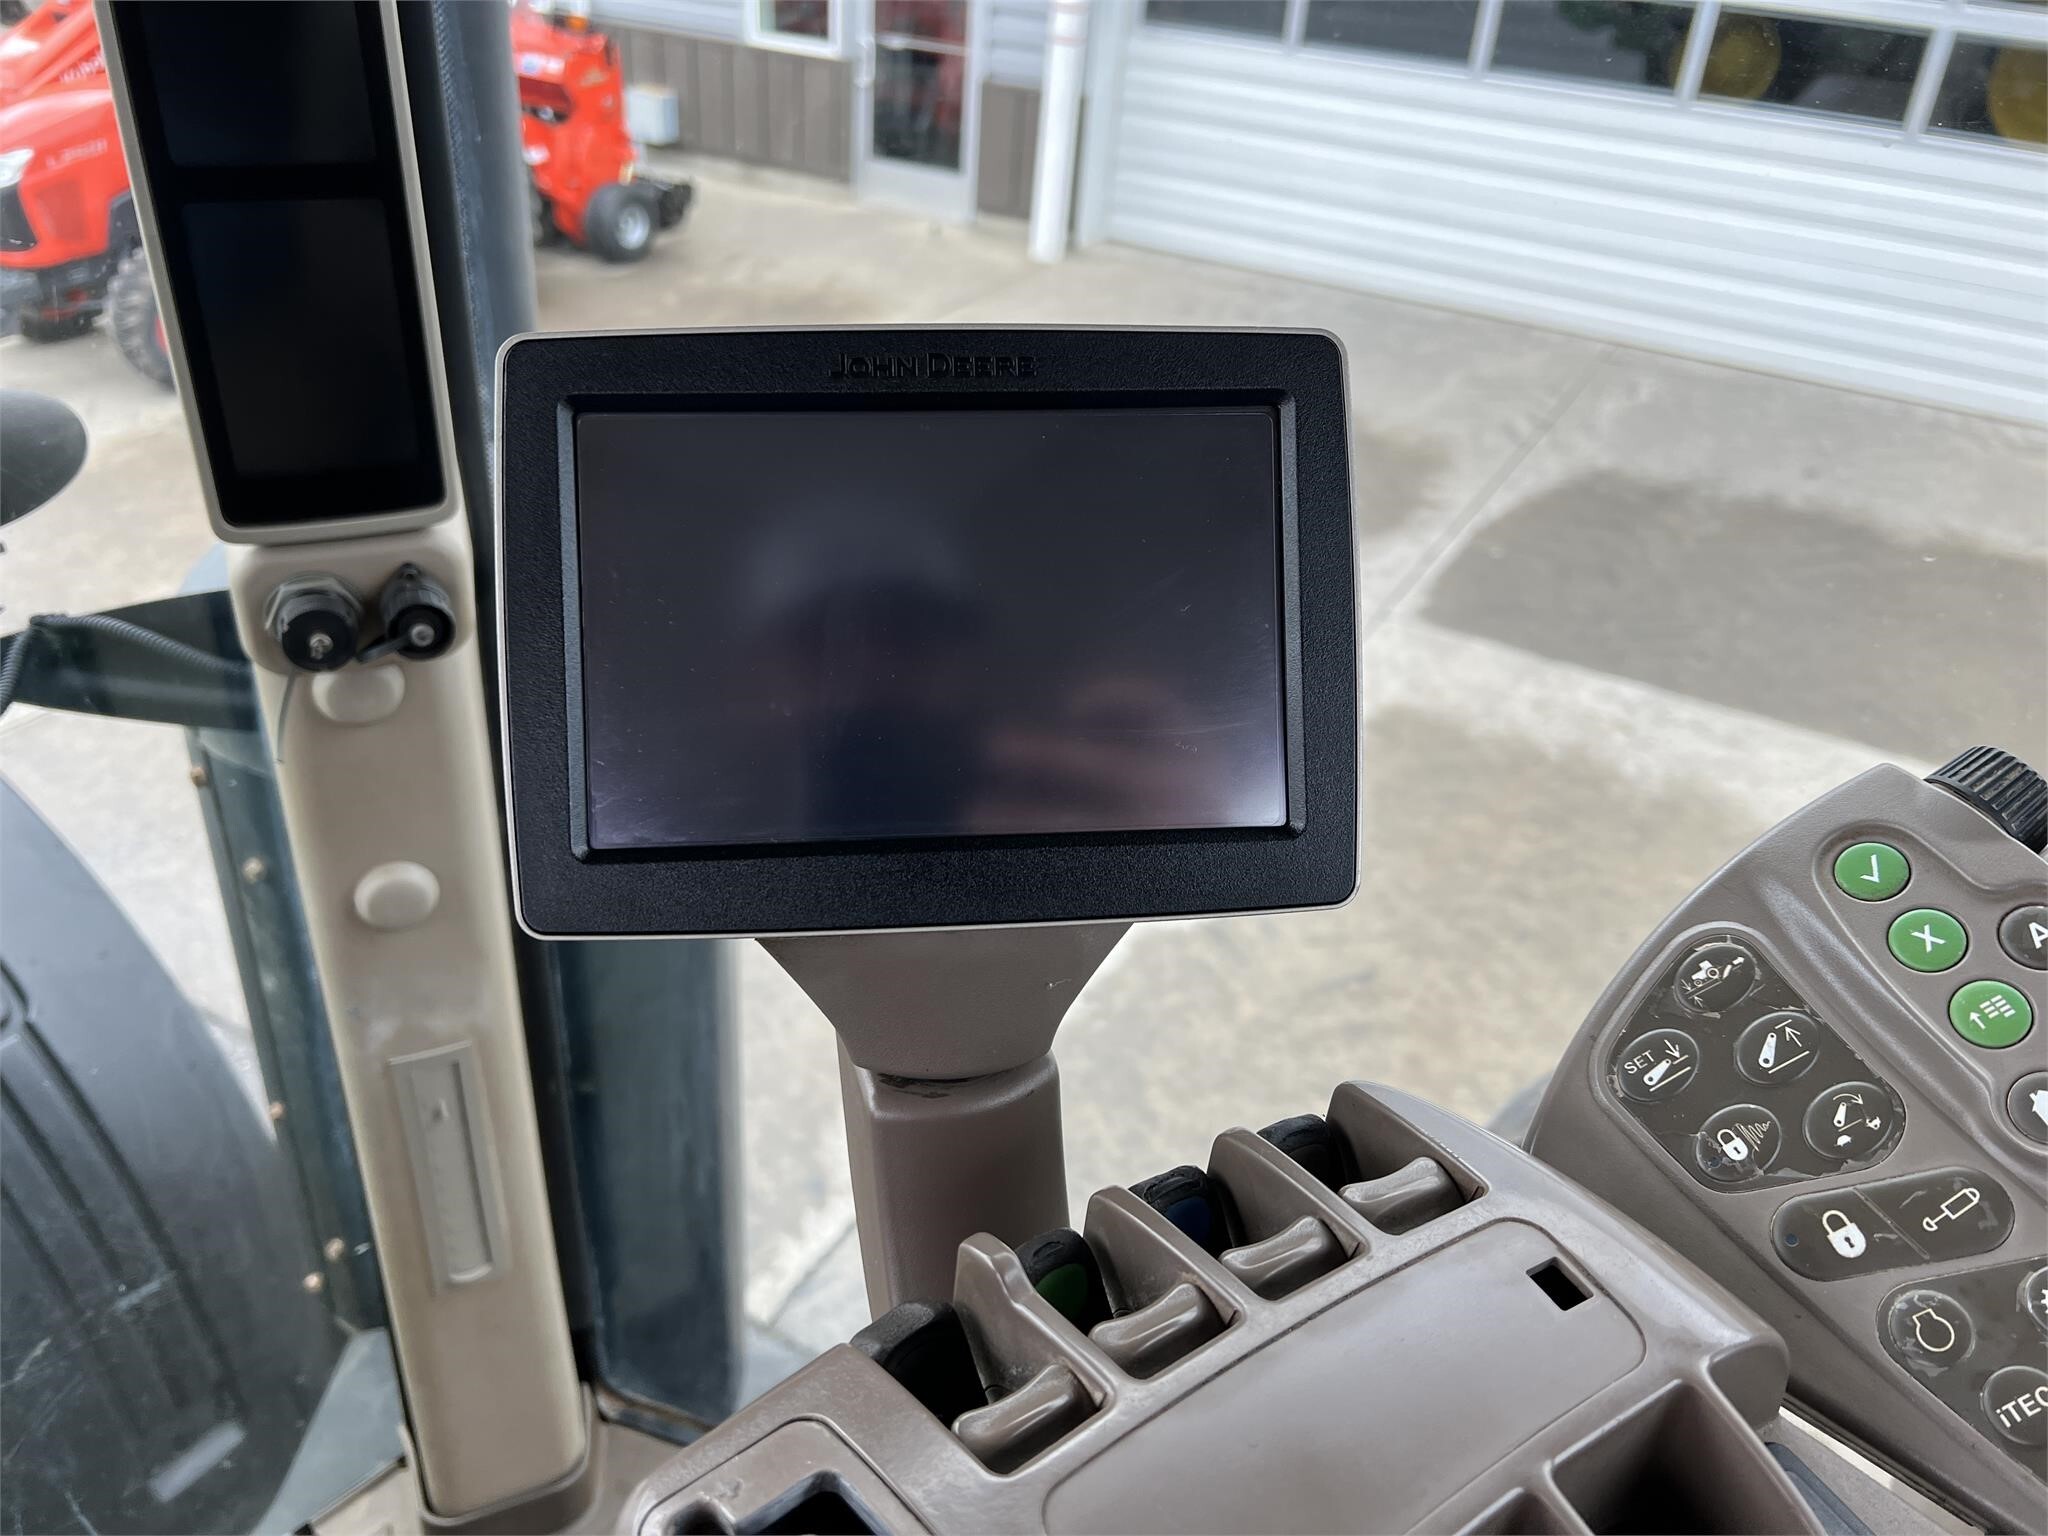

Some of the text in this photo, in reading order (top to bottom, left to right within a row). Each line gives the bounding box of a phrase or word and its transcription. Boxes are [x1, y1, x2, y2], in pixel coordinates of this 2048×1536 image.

[829, 353, 1038, 377] JOHN DEERE
[1623, 1049, 1656, 1075] SET
